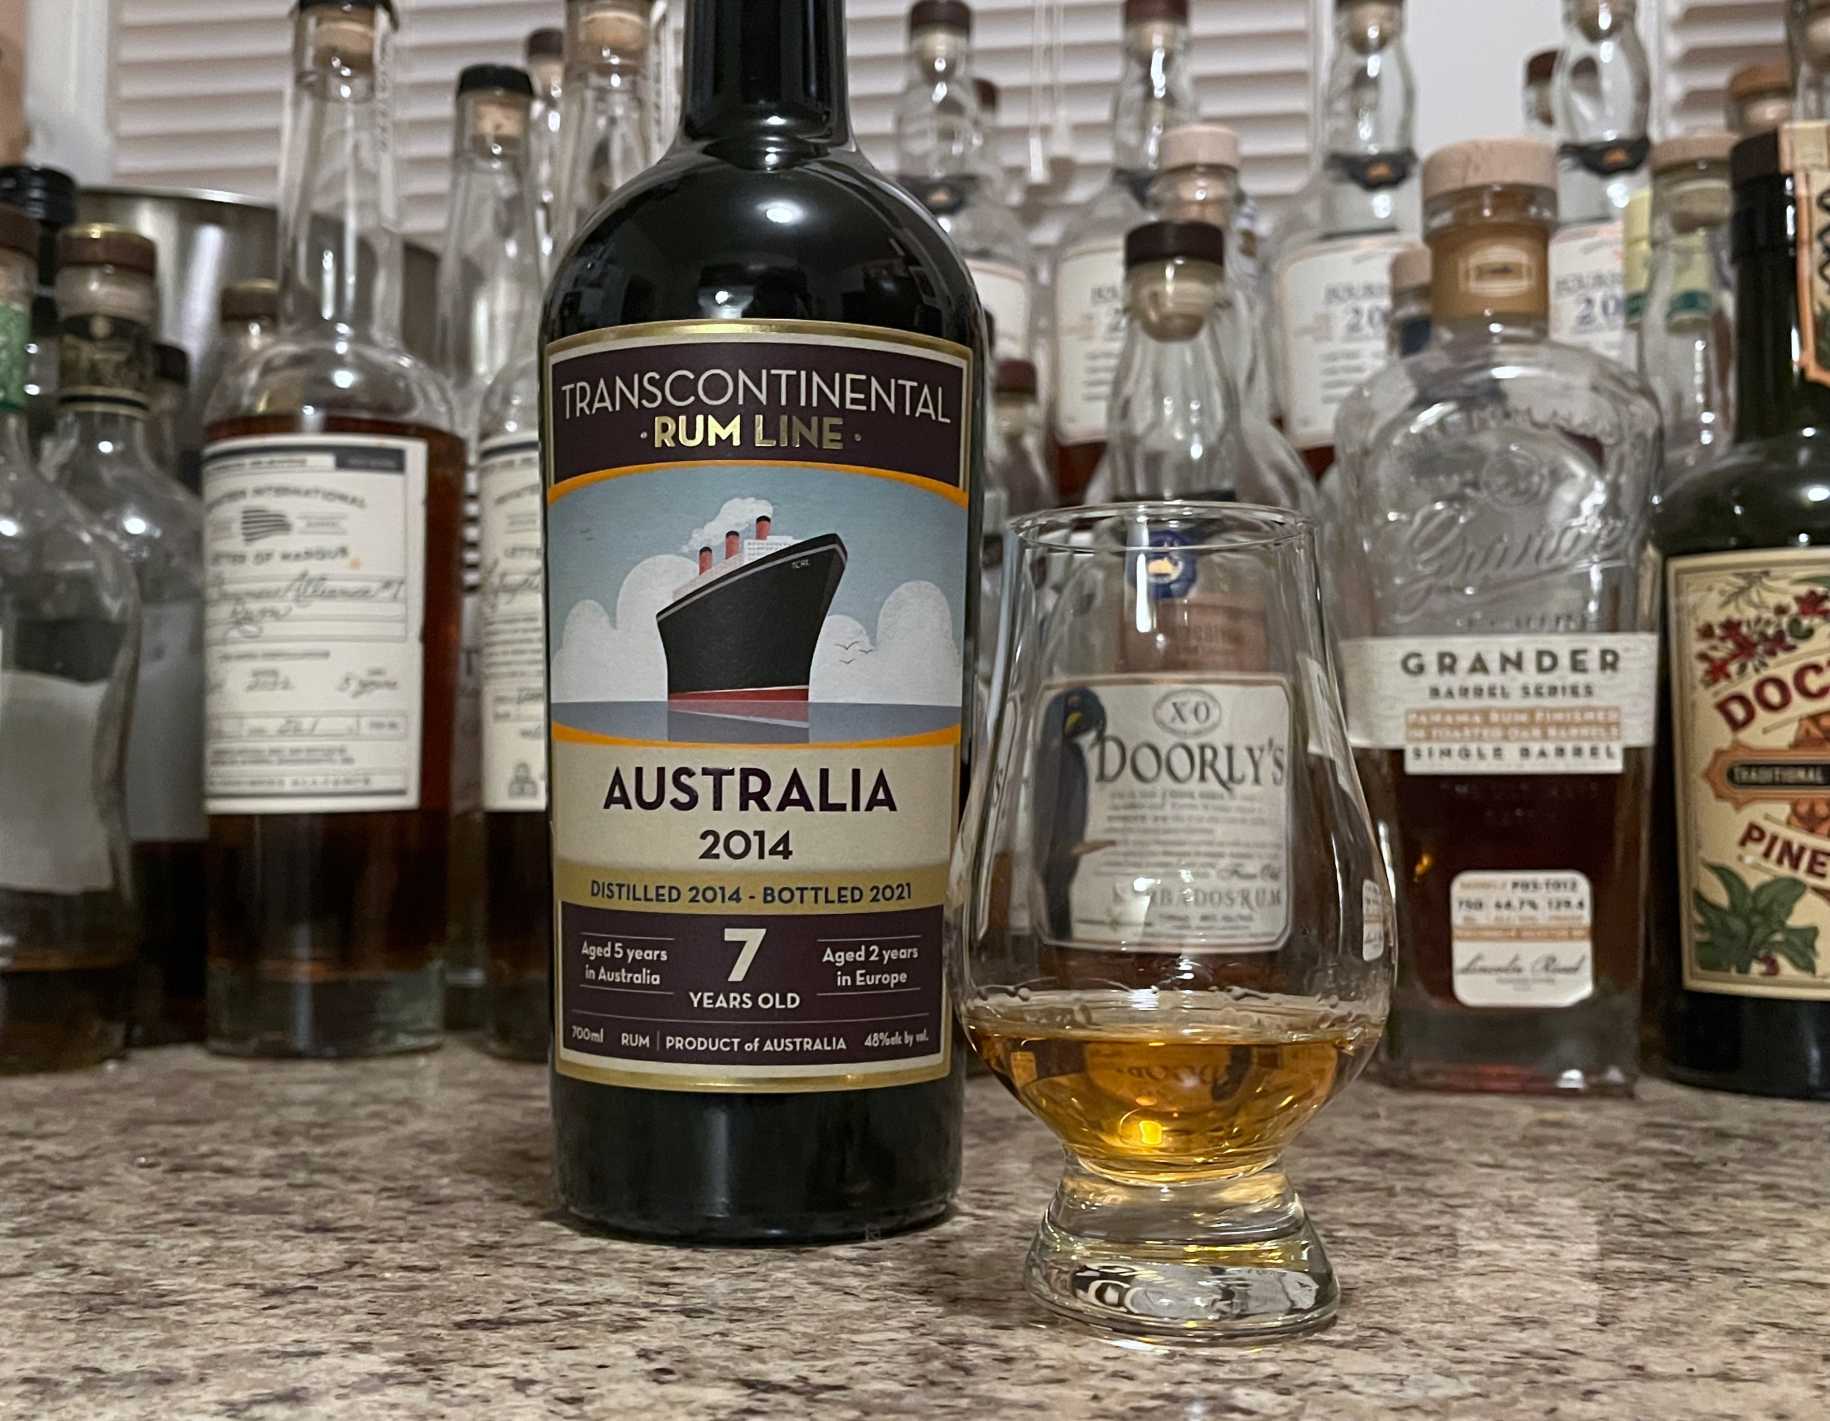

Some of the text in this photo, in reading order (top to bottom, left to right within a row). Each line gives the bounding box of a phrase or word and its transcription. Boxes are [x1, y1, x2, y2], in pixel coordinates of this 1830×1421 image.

[561, 368, 951, 424] TRANSCONTINENTAL
[654, 414, 844, 450] RUM LINE
[1401, 648, 1620, 676] GRANDER
[1429, 684, 1594, 700] BARREL SERIES
[1095, 735, 1285, 791] DOORLY'S
[1412, 745, 1616, 760] SINGLE BARREL
[603, 766, 897, 812] AUSTRALIA
[699, 829, 793, 860] 2014
[591, 880, 681, 903] DISTILLED
[688, 885, 742, 904] 2014
[763, 886, 863, 904] BOTTLED
[869, 882, 912, 903] 2021
[581, 940, 668, 963] Aged 5 years
[723, 927, 768, 982] 7
[822, 945, 919, 966] Aged 2 years
[585, 964, 661, 985] in Australia
[836, 969, 908, 989] in Europe
[688, 991, 801, 1009] YEARS OLD
[571, 1025, 604, 1043] 700ml
[620, 1032, 650, 1048] RUM
[665, 1036, 741, 1051] PRODUCT
[744, 1037, 761, 1051] of
[762, 1037, 848, 1051] AUSTRALIA
